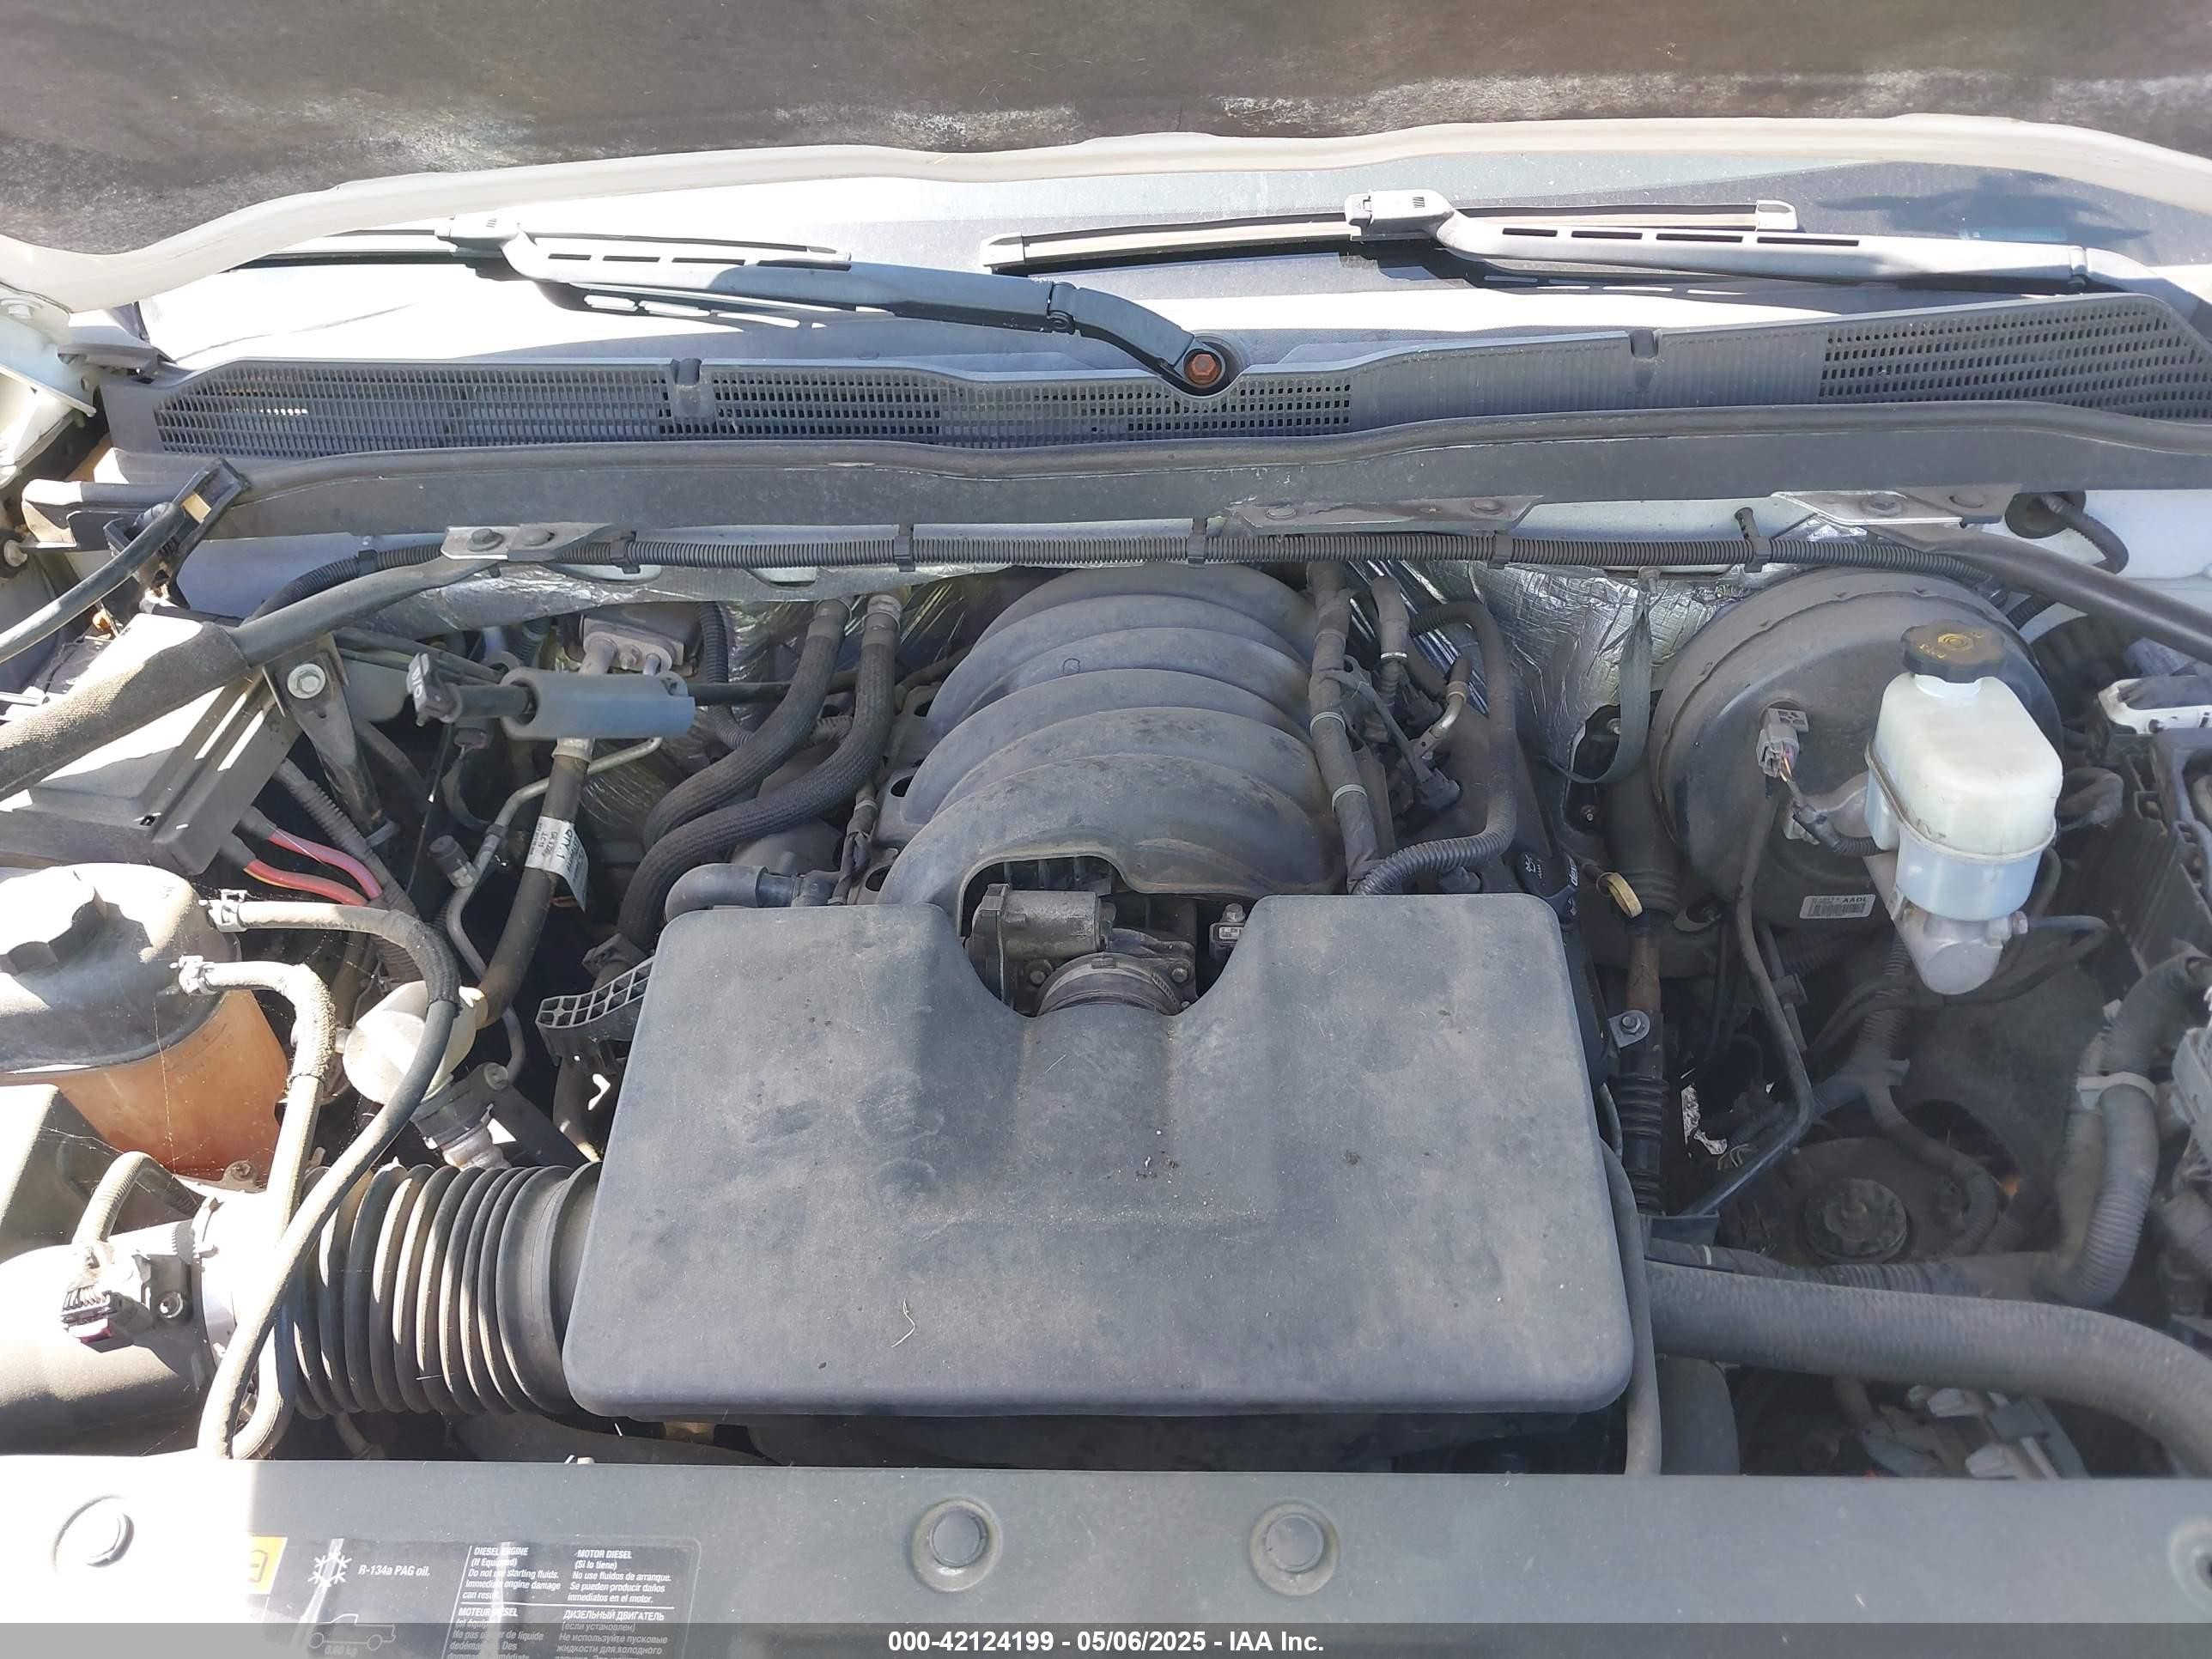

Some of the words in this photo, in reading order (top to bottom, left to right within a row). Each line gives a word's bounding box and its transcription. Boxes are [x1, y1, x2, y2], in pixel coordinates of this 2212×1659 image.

[475, 1547, 498, 1556] DIESEL
[501, 1547, 529, 1556] GINE
[577, 1550, 605, 1559] MOTOR
[606, 1550, 633, 1559] DIESEL
[482, 1558, 518, 1568] Equipd)
[597, 1561, 617, 1571] tiene)
[358, 1565, 393, 1576] R-134a
[395, 1565, 416, 1577] PAG
[416, 1566, 431, 1577] oil.
[469, 1569, 477, 1577] Do
[480, 1569, 492, 1577] not
[507, 1570, 536, 1580] starting
[538, 1571, 560, 1579] fluids.
[574, 1571, 582, 1580] No
[600, 1572, 625, 1581] fluidos
[626, 1572, 635, 1581] de
[637, 1575, 672, 1583] arranque.
[504, 1581, 531, 1590] engine
[532, 1582, 562, 1591] damage
[571, 1582, 580, 1590] Se
[581, 1583, 609, 1592] pueden
[611, 1583, 641, 1592] producir
[643, 1584, 665, 1593] daños
[568, 1593, 608, 1602] inmediatos
[621, 1594, 629, 1602] el
[629, 1595, 653, 1603] motor.
[459, 1607, 490, 1616] MOTEUR
[491, 1607, 519, 1617] ESEL
[563, 1609, 617, 1620] ДИЗЕЛЬНЫЙ
[617, 1612, 665, 1621] ДВИГАТЕЛЬ
[453, 1630, 464, 1638] Ne
[465, 1632, 478, 1641] pas
[507, 1631, 517, 1639] de
[518, 1632, 544, 1641] liquide
[502, 1642, 518, 1650] Des
